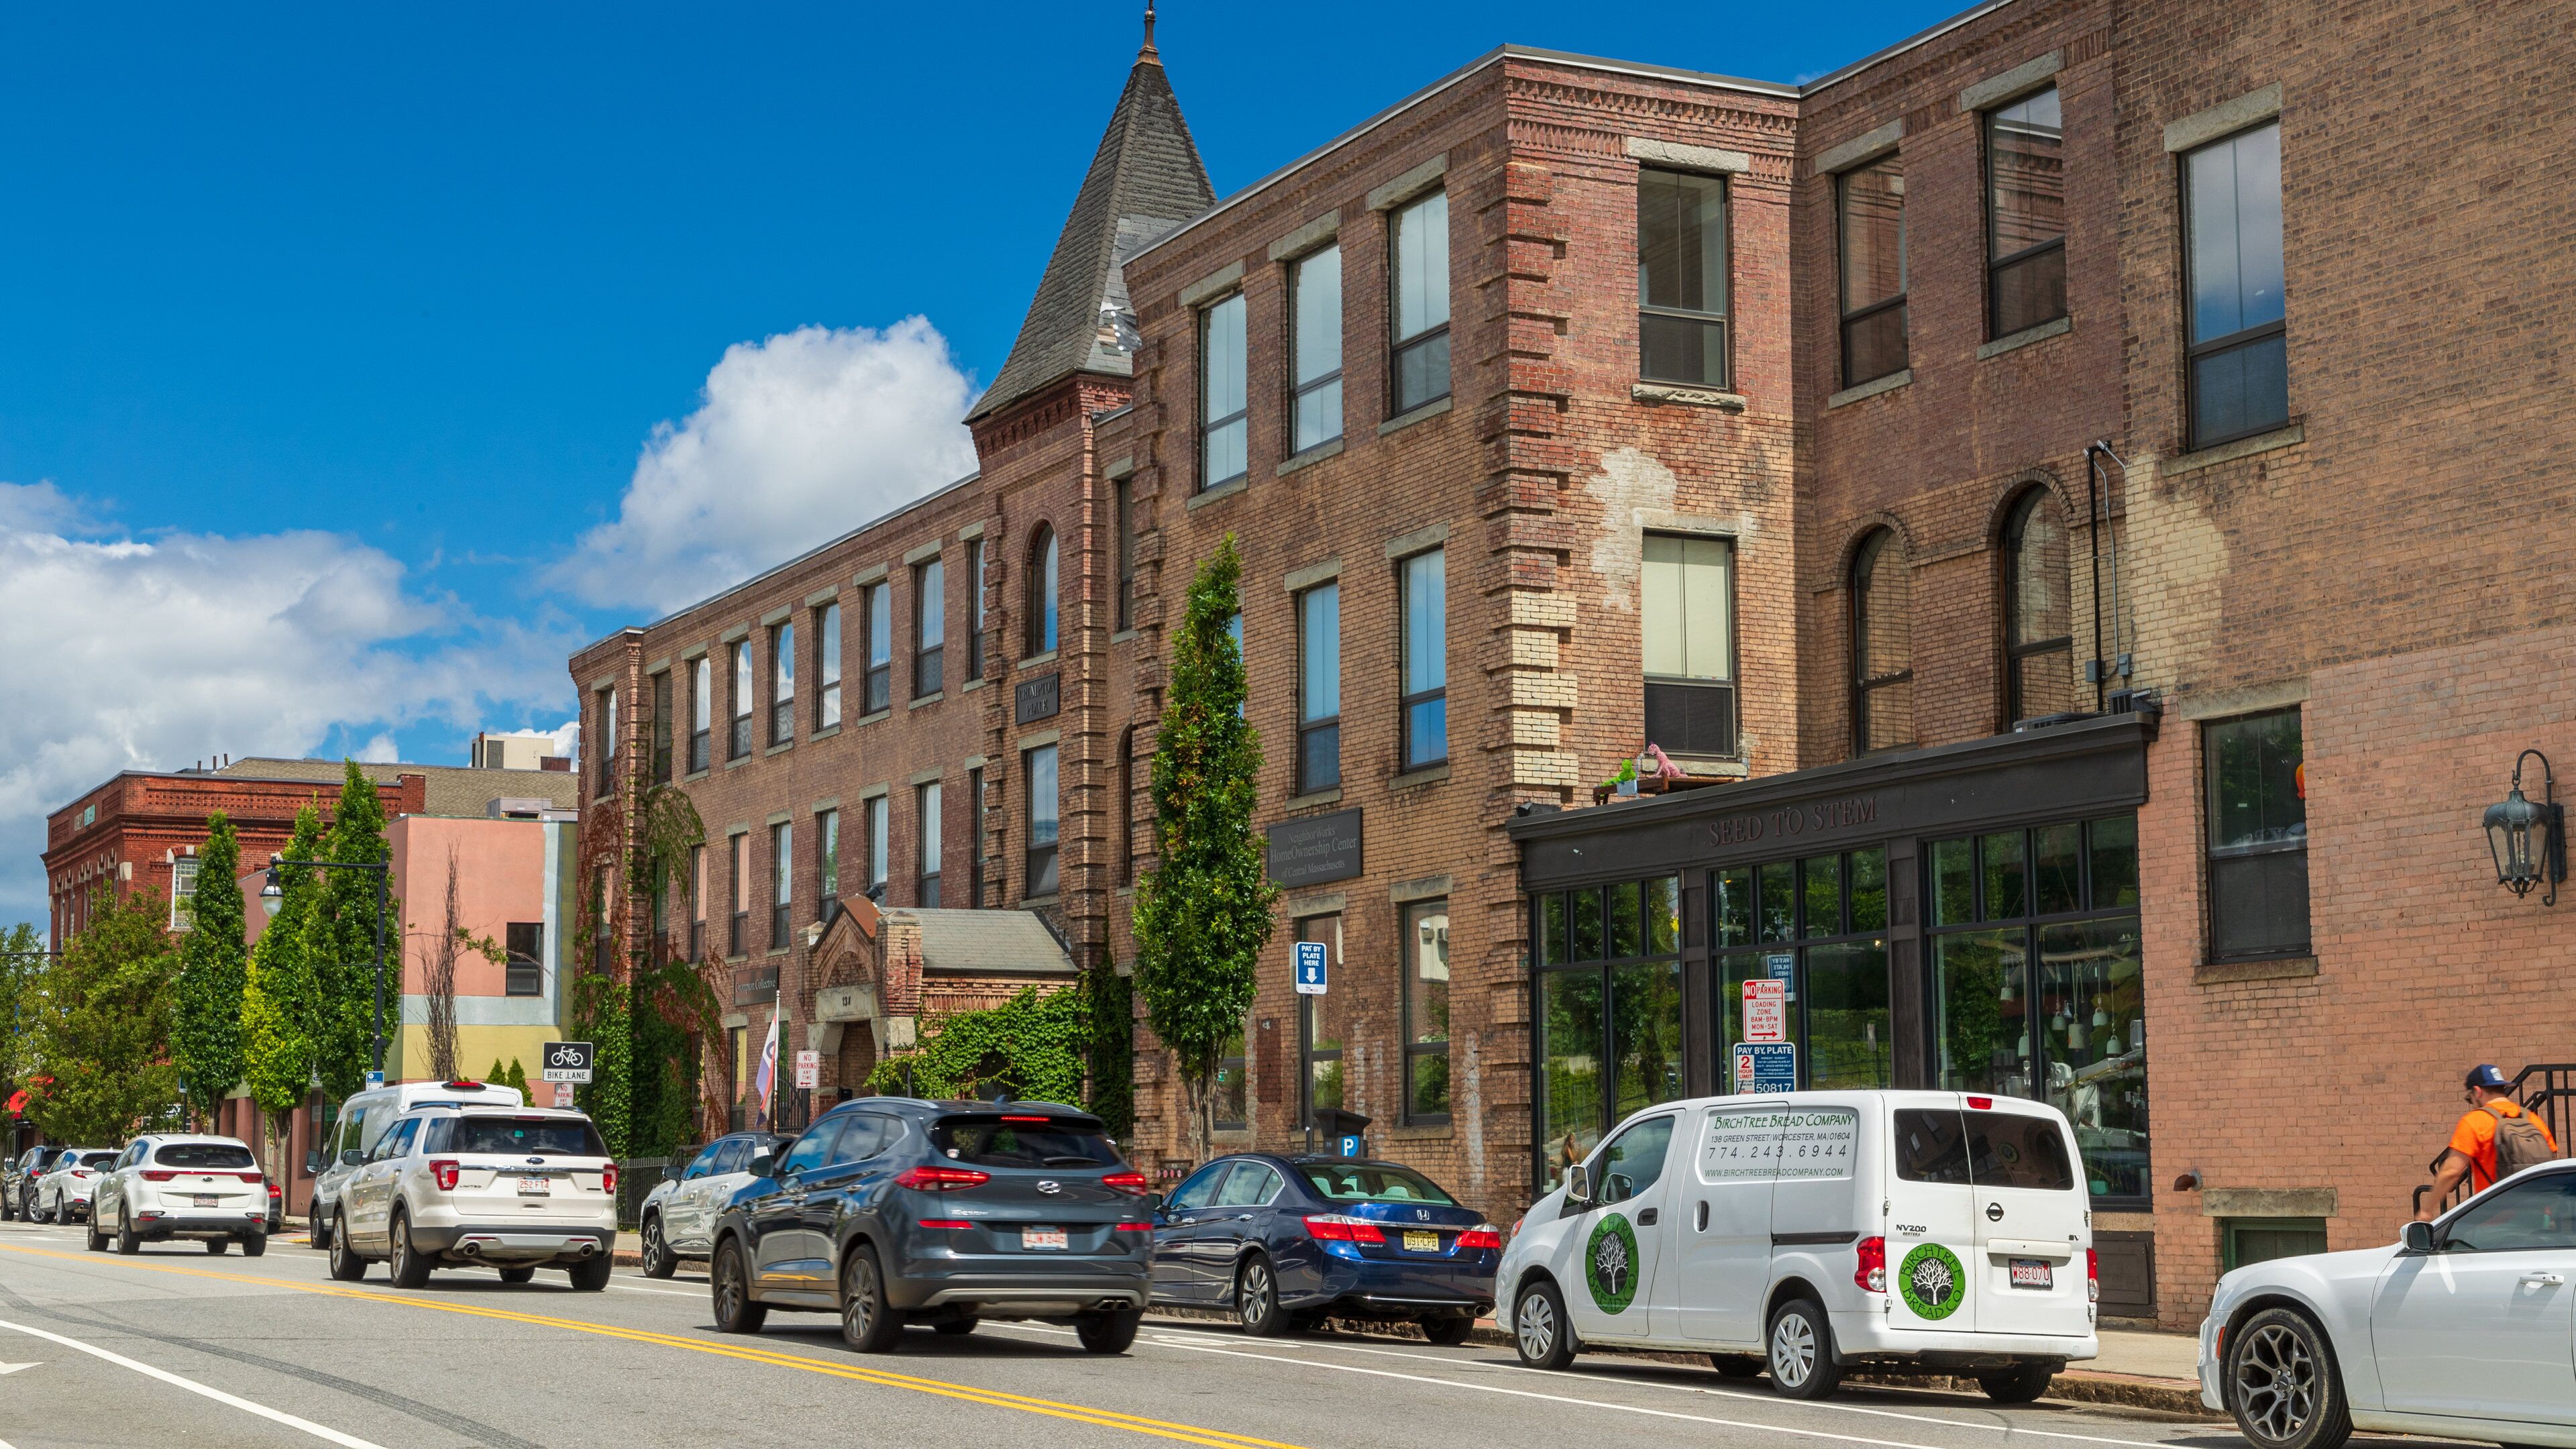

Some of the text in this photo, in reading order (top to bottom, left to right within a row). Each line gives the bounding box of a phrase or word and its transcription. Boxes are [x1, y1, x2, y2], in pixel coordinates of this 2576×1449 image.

[1018, 679, 1056, 702] CROMPTON
[1026, 699, 1047, 717] PLACE
[1710, 795, 1877, 847] SEED TO STEM
[1271, 837, 1357, 863] HomeOwnership Center
[1282, 859, 1346, 878] of Central Massachusetts
[755, 977, 775, 989] Collective
[1745, 985, 1782, 997] NO PARKING
[1737, 1046, 1752, 1055] PAY
[1754, 1046, 1765, 1055] BY
[1741, 1056, 1750, 1069] 2
[547, 1071, 586, 1079] BIKE LANE
[1756, 1083, 1792, 1093] 50817
[1769, 1114, 1804, 1128] BREAD
[1723, 1134, 1744, 1143] GREEN
[1344, 1138, 1354, 1157] P
[1705, 1168, 1843, 1177] WWW.BIRCHTREEBREADCOMPANY.COM
[520, 1181, 533, 1189] 252
[1896, 1224, 1927, 1232] NV200
[1587, 1216, 1636, 1258] BIRCHTREE
[1901, 1245, 1962, 1280] BIRCHTREE
[1588, 1271, 1622, 1311] BREAD
[1902, 1287, 1964, 1319] BREAD CO.
